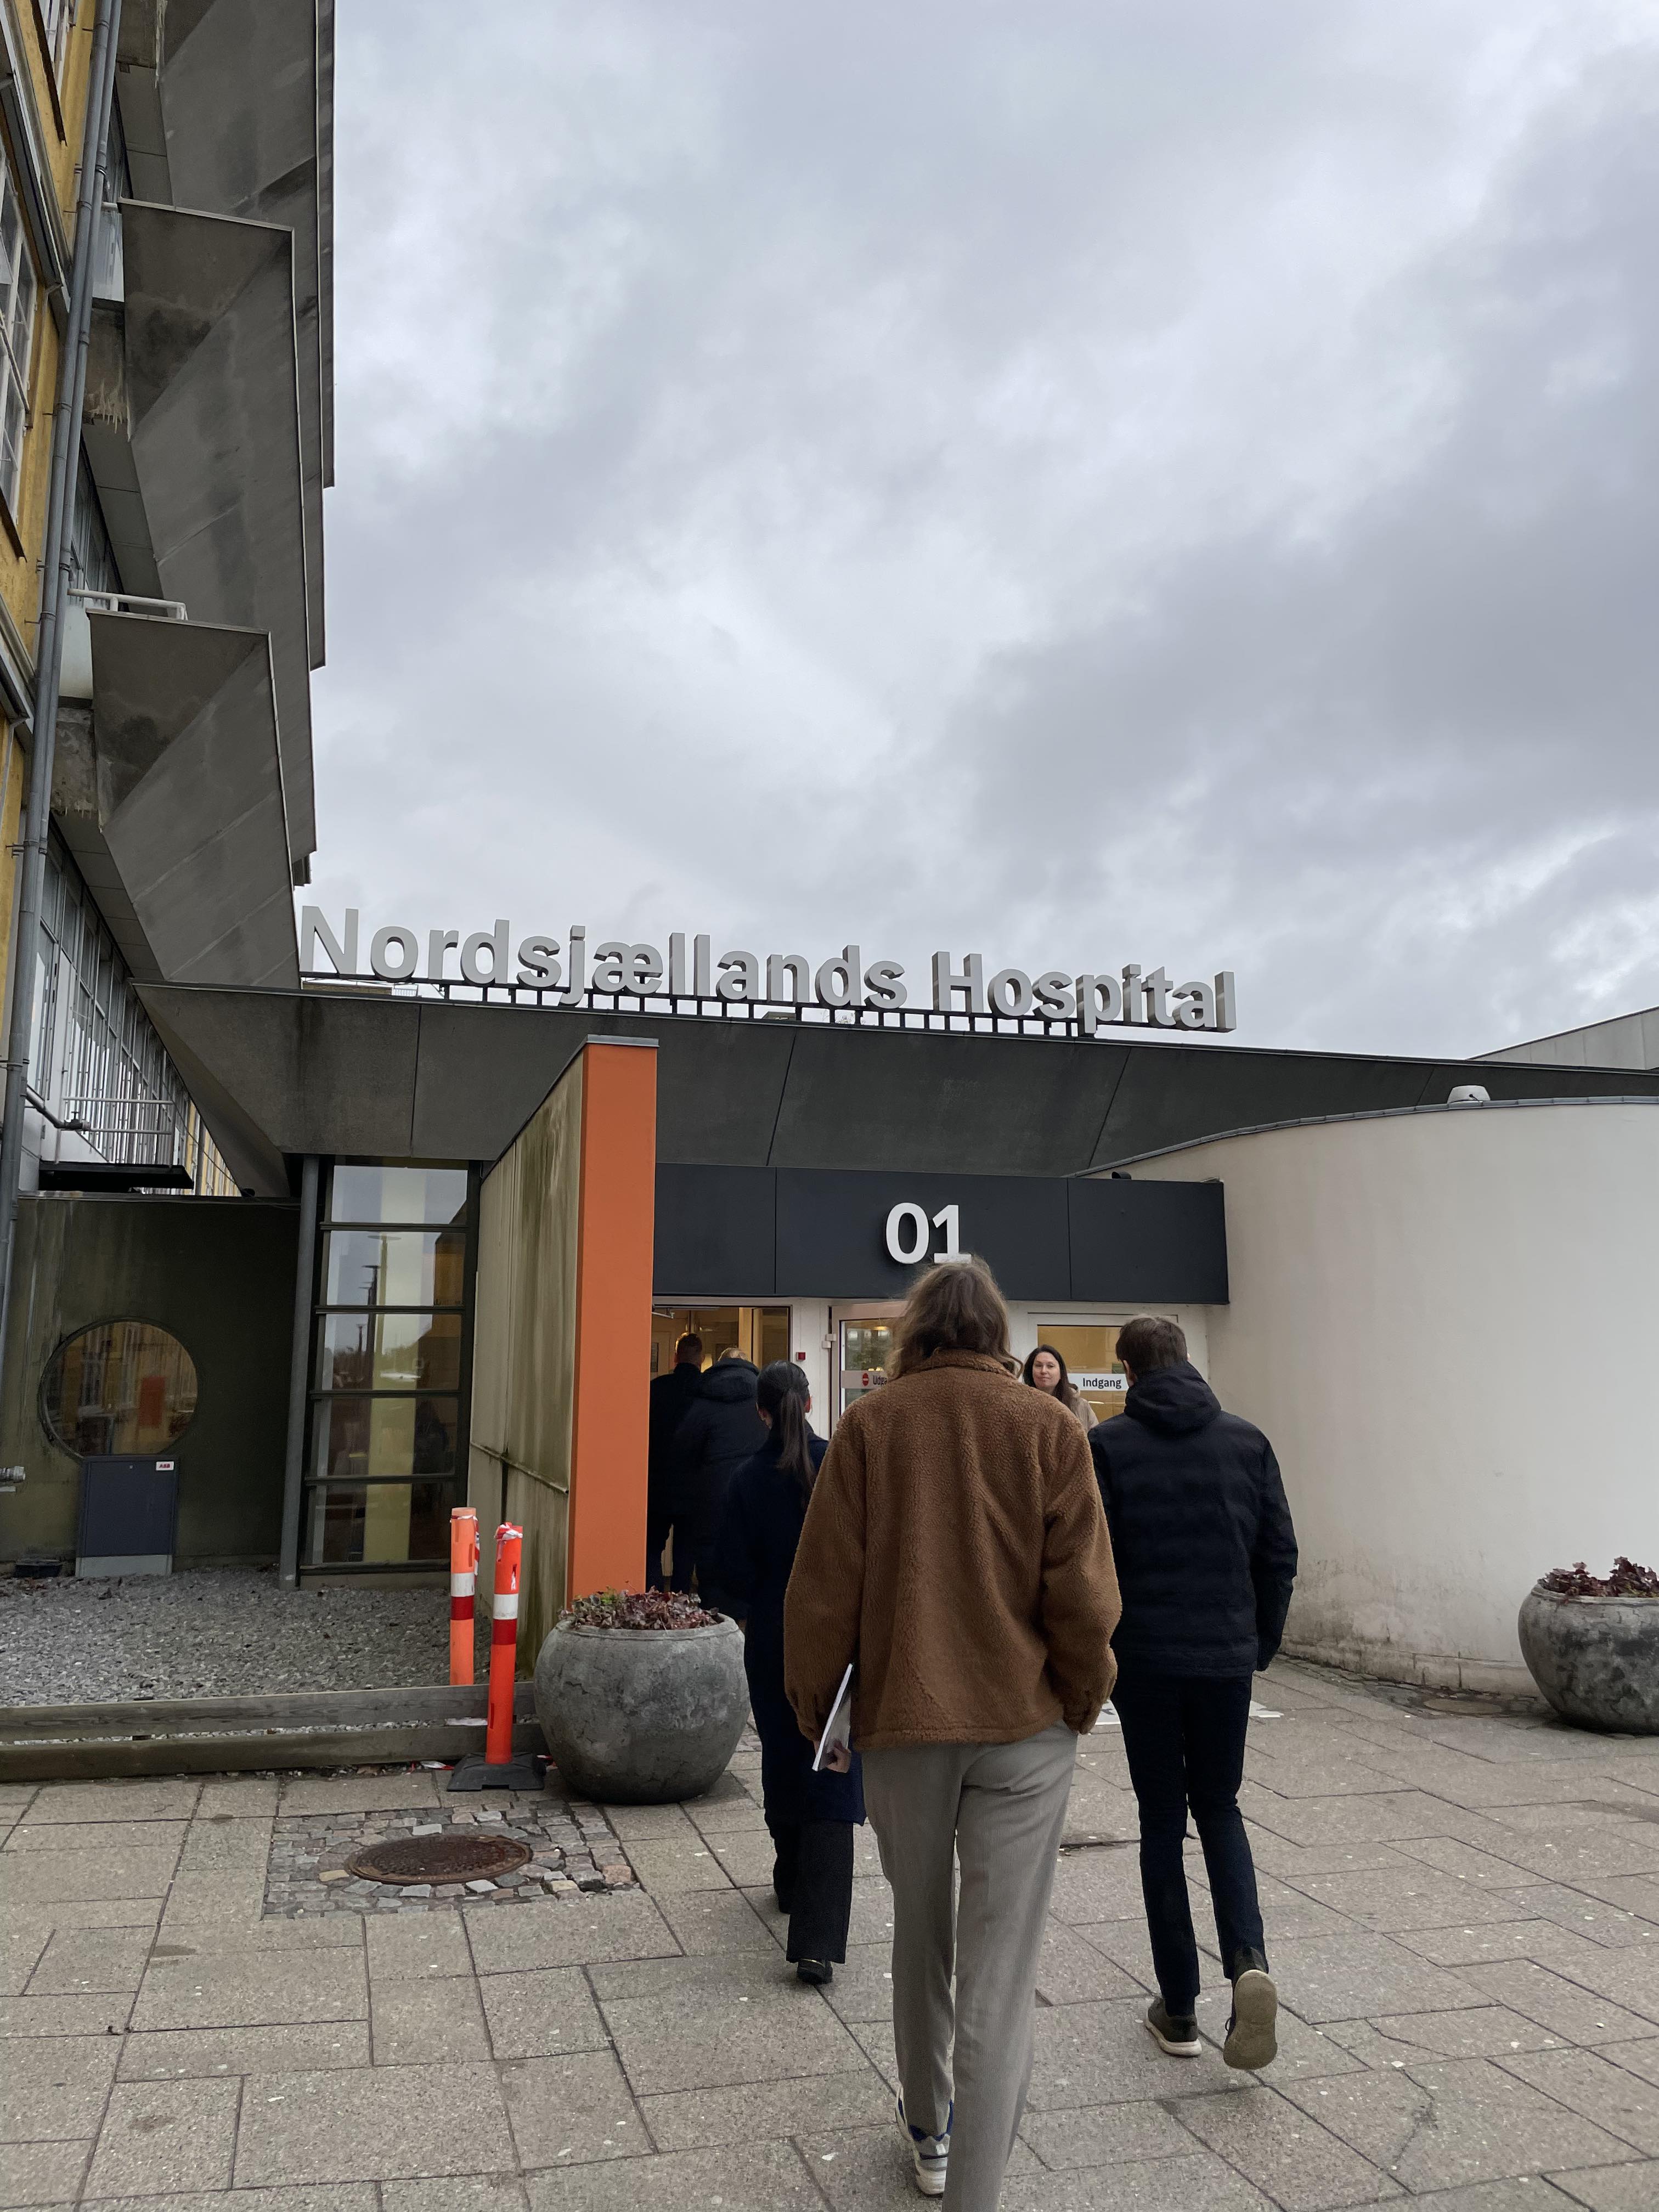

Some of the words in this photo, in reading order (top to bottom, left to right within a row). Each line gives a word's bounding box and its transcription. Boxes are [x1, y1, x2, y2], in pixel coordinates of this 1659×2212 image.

[299, 905, 907, 1009] Nordsjællands
[931, 951, 1237, 1037] Hospital
[886, 1202, 972, 1264] 01
[1082, 1378, 1121, 1389] Indgang
